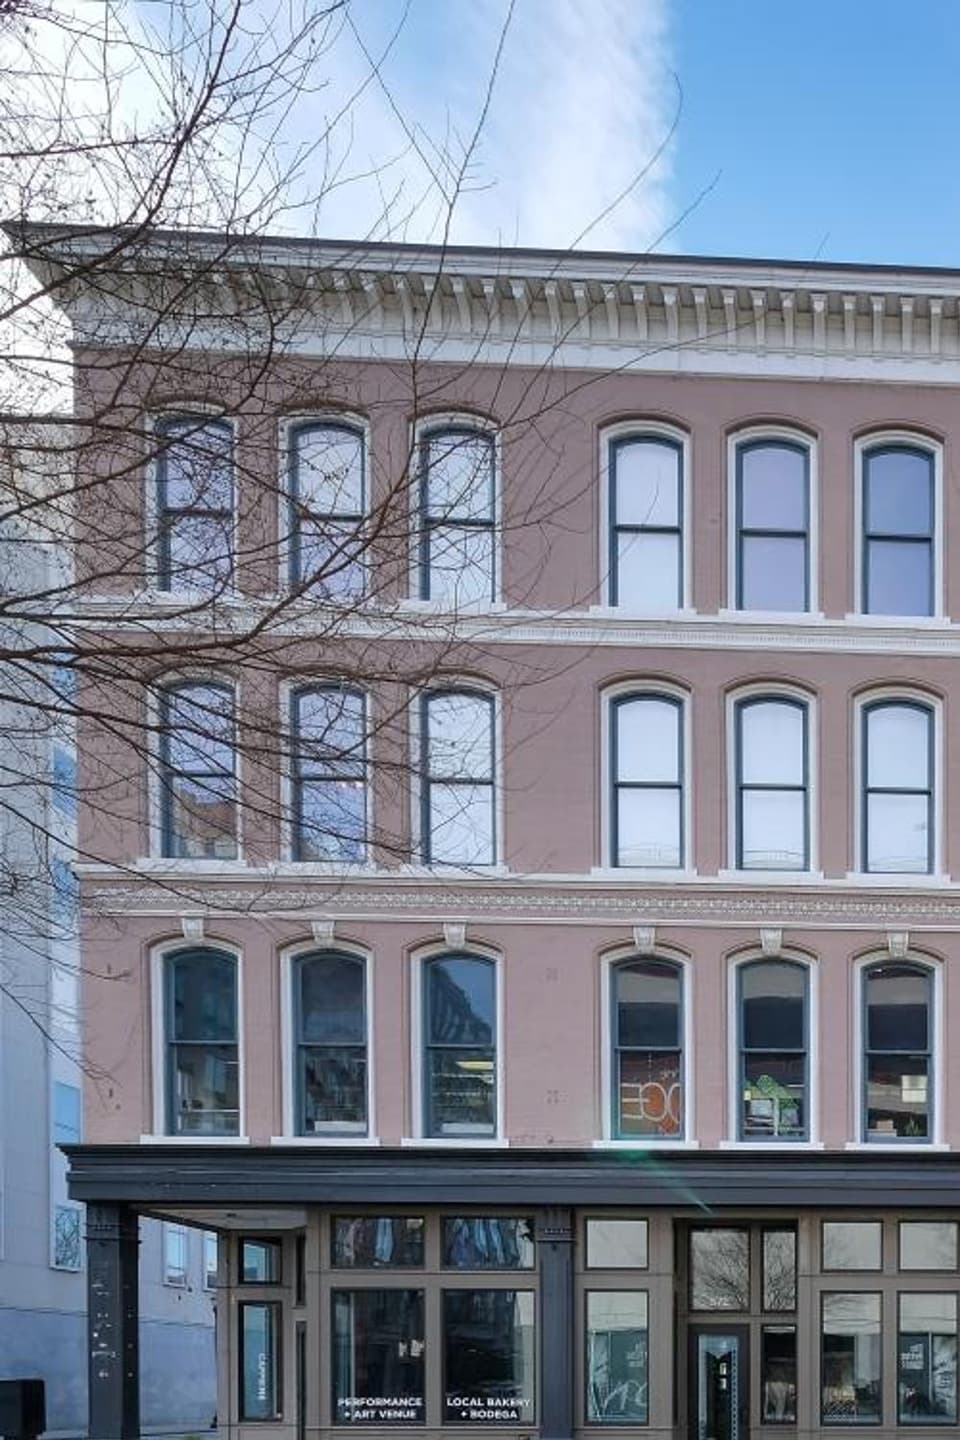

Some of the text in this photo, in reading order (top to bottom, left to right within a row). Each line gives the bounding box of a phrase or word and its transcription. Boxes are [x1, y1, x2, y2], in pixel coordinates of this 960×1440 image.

[337, 1397, 423, 1407] PERFORMANCE
[446, 1397, 531, 1407] LOCAL BAKERY
[354, 1410, 376, 1419] ART
[379, 1410, 417, 1419] VENUE
[469, 1410, 518, 1419] BODEGA
